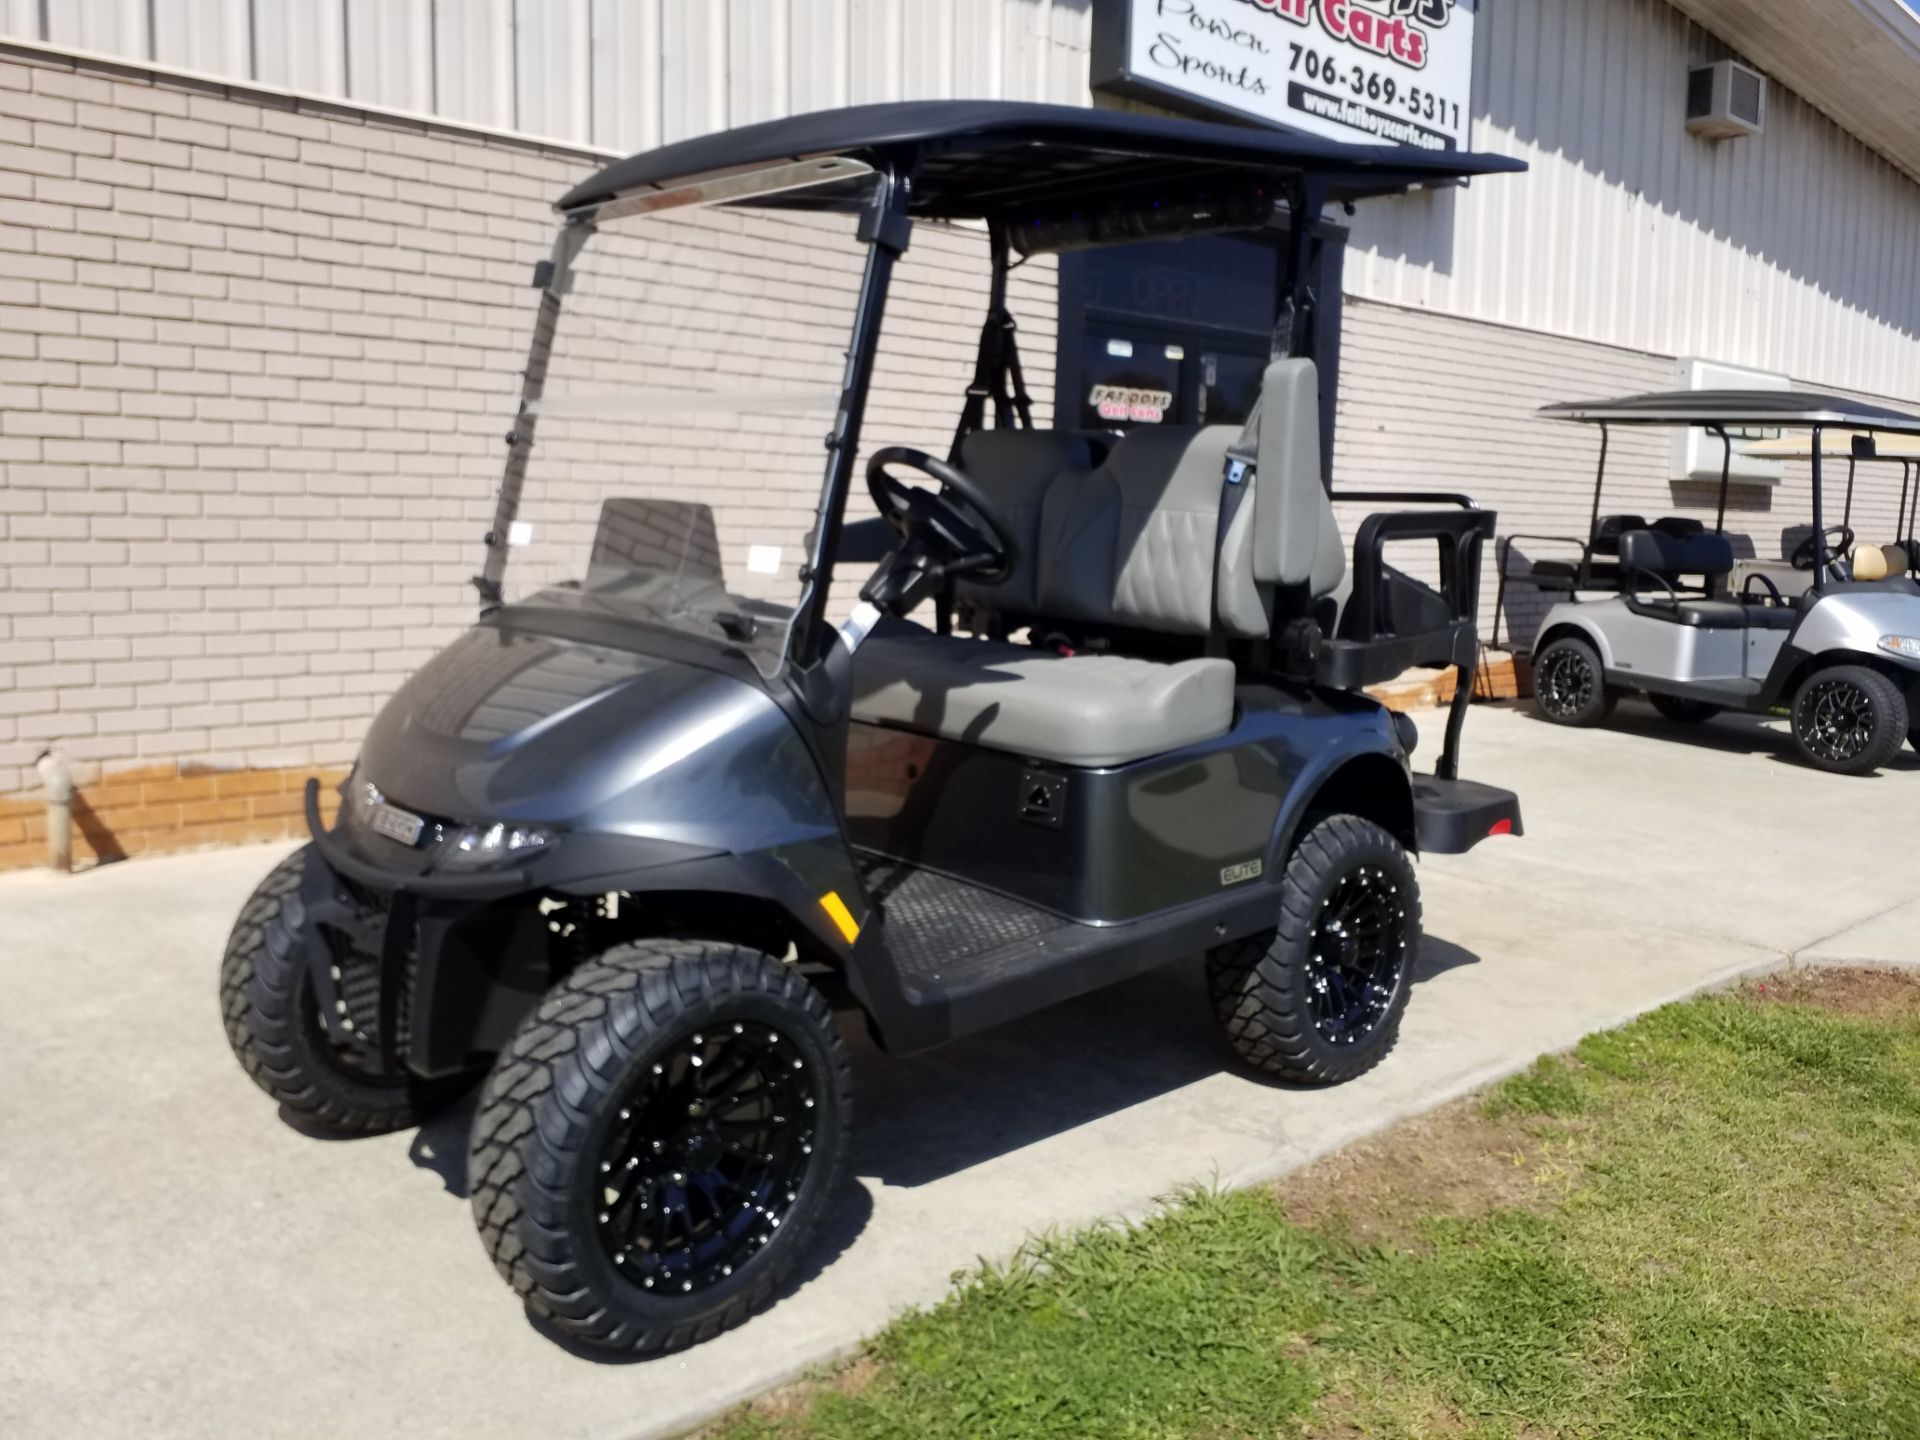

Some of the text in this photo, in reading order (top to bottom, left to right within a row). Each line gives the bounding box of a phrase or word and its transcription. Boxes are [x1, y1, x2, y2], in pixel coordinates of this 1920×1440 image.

[1149, 32, 1270, 95] Sports
[1318, 0, 1426, 68] Carts
[1289, 41, 1459, 130] 706-369-5311
[1302, 91, 1446, 151] www.fatboyscarts.com
